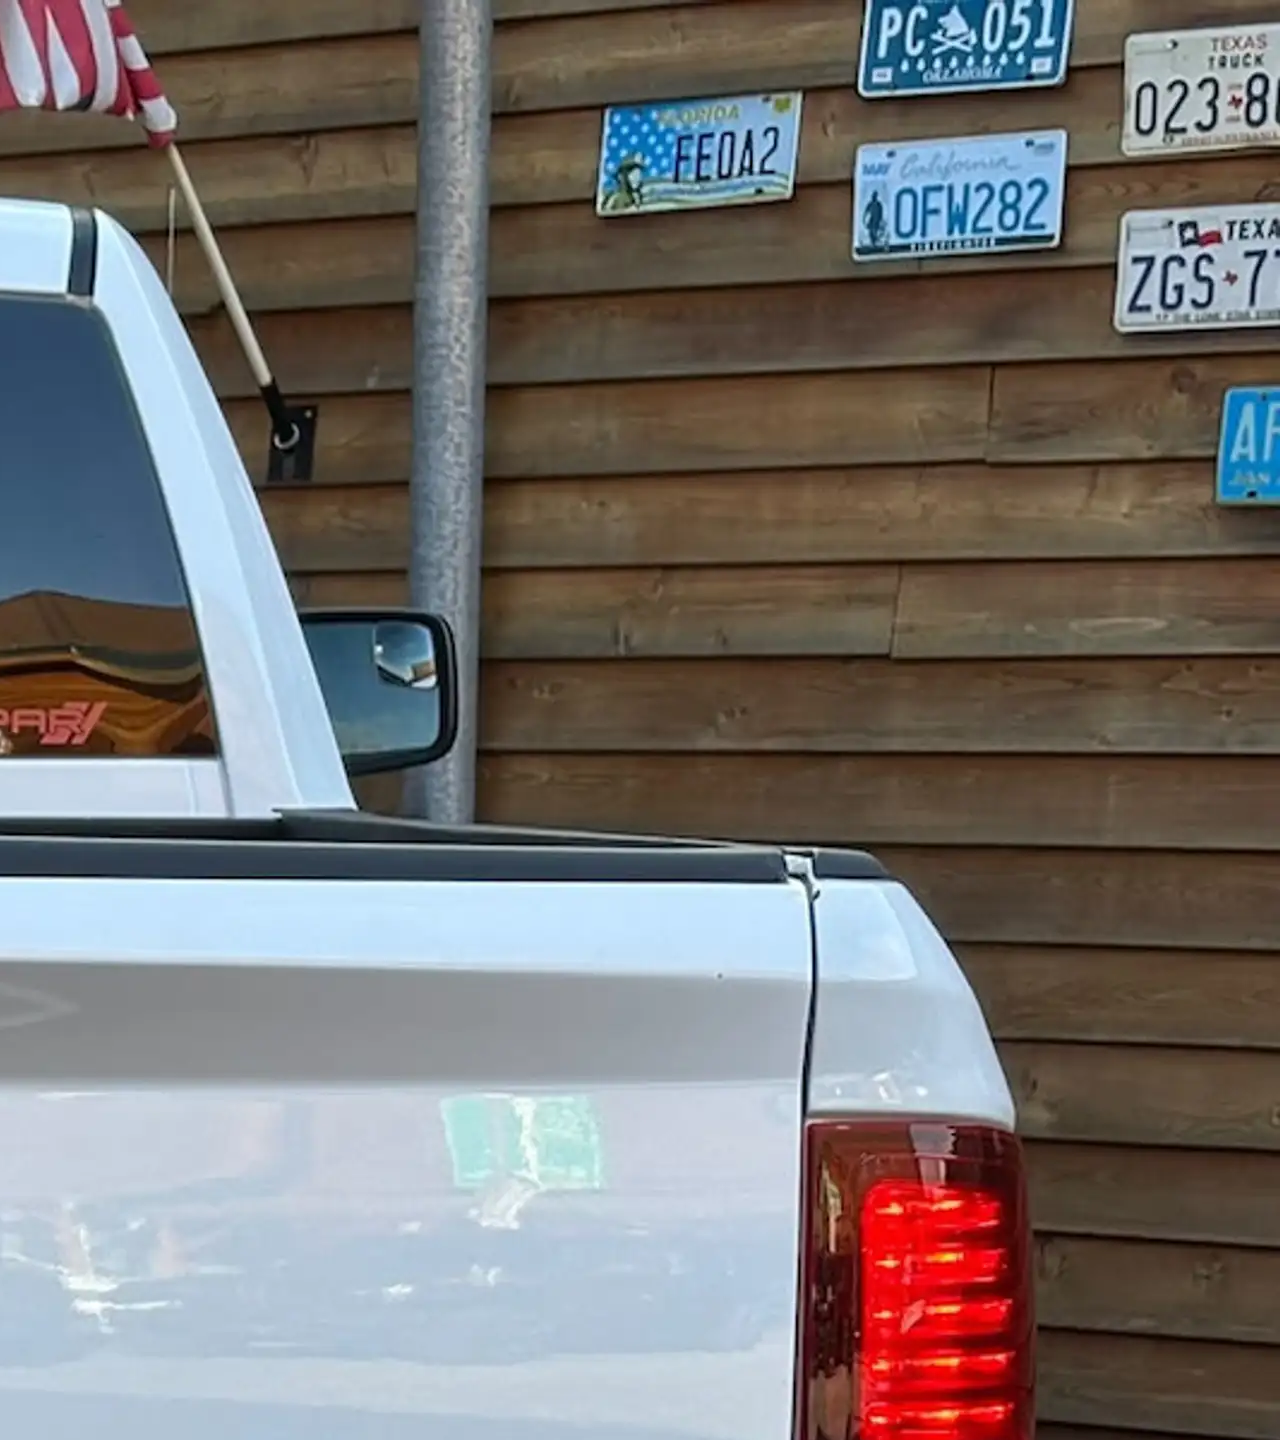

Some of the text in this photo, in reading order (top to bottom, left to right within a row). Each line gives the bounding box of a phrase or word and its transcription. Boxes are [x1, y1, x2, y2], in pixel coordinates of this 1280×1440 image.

[877, 0, 1055, 58] PC 051
[1211, 34, 1267, 52] TEXAS
[1208, 53, 1264, 69] TRUCK
[1136, 71, 1280, 136] 023 8
[1127, 249, 1280, 314] ZGS 7
